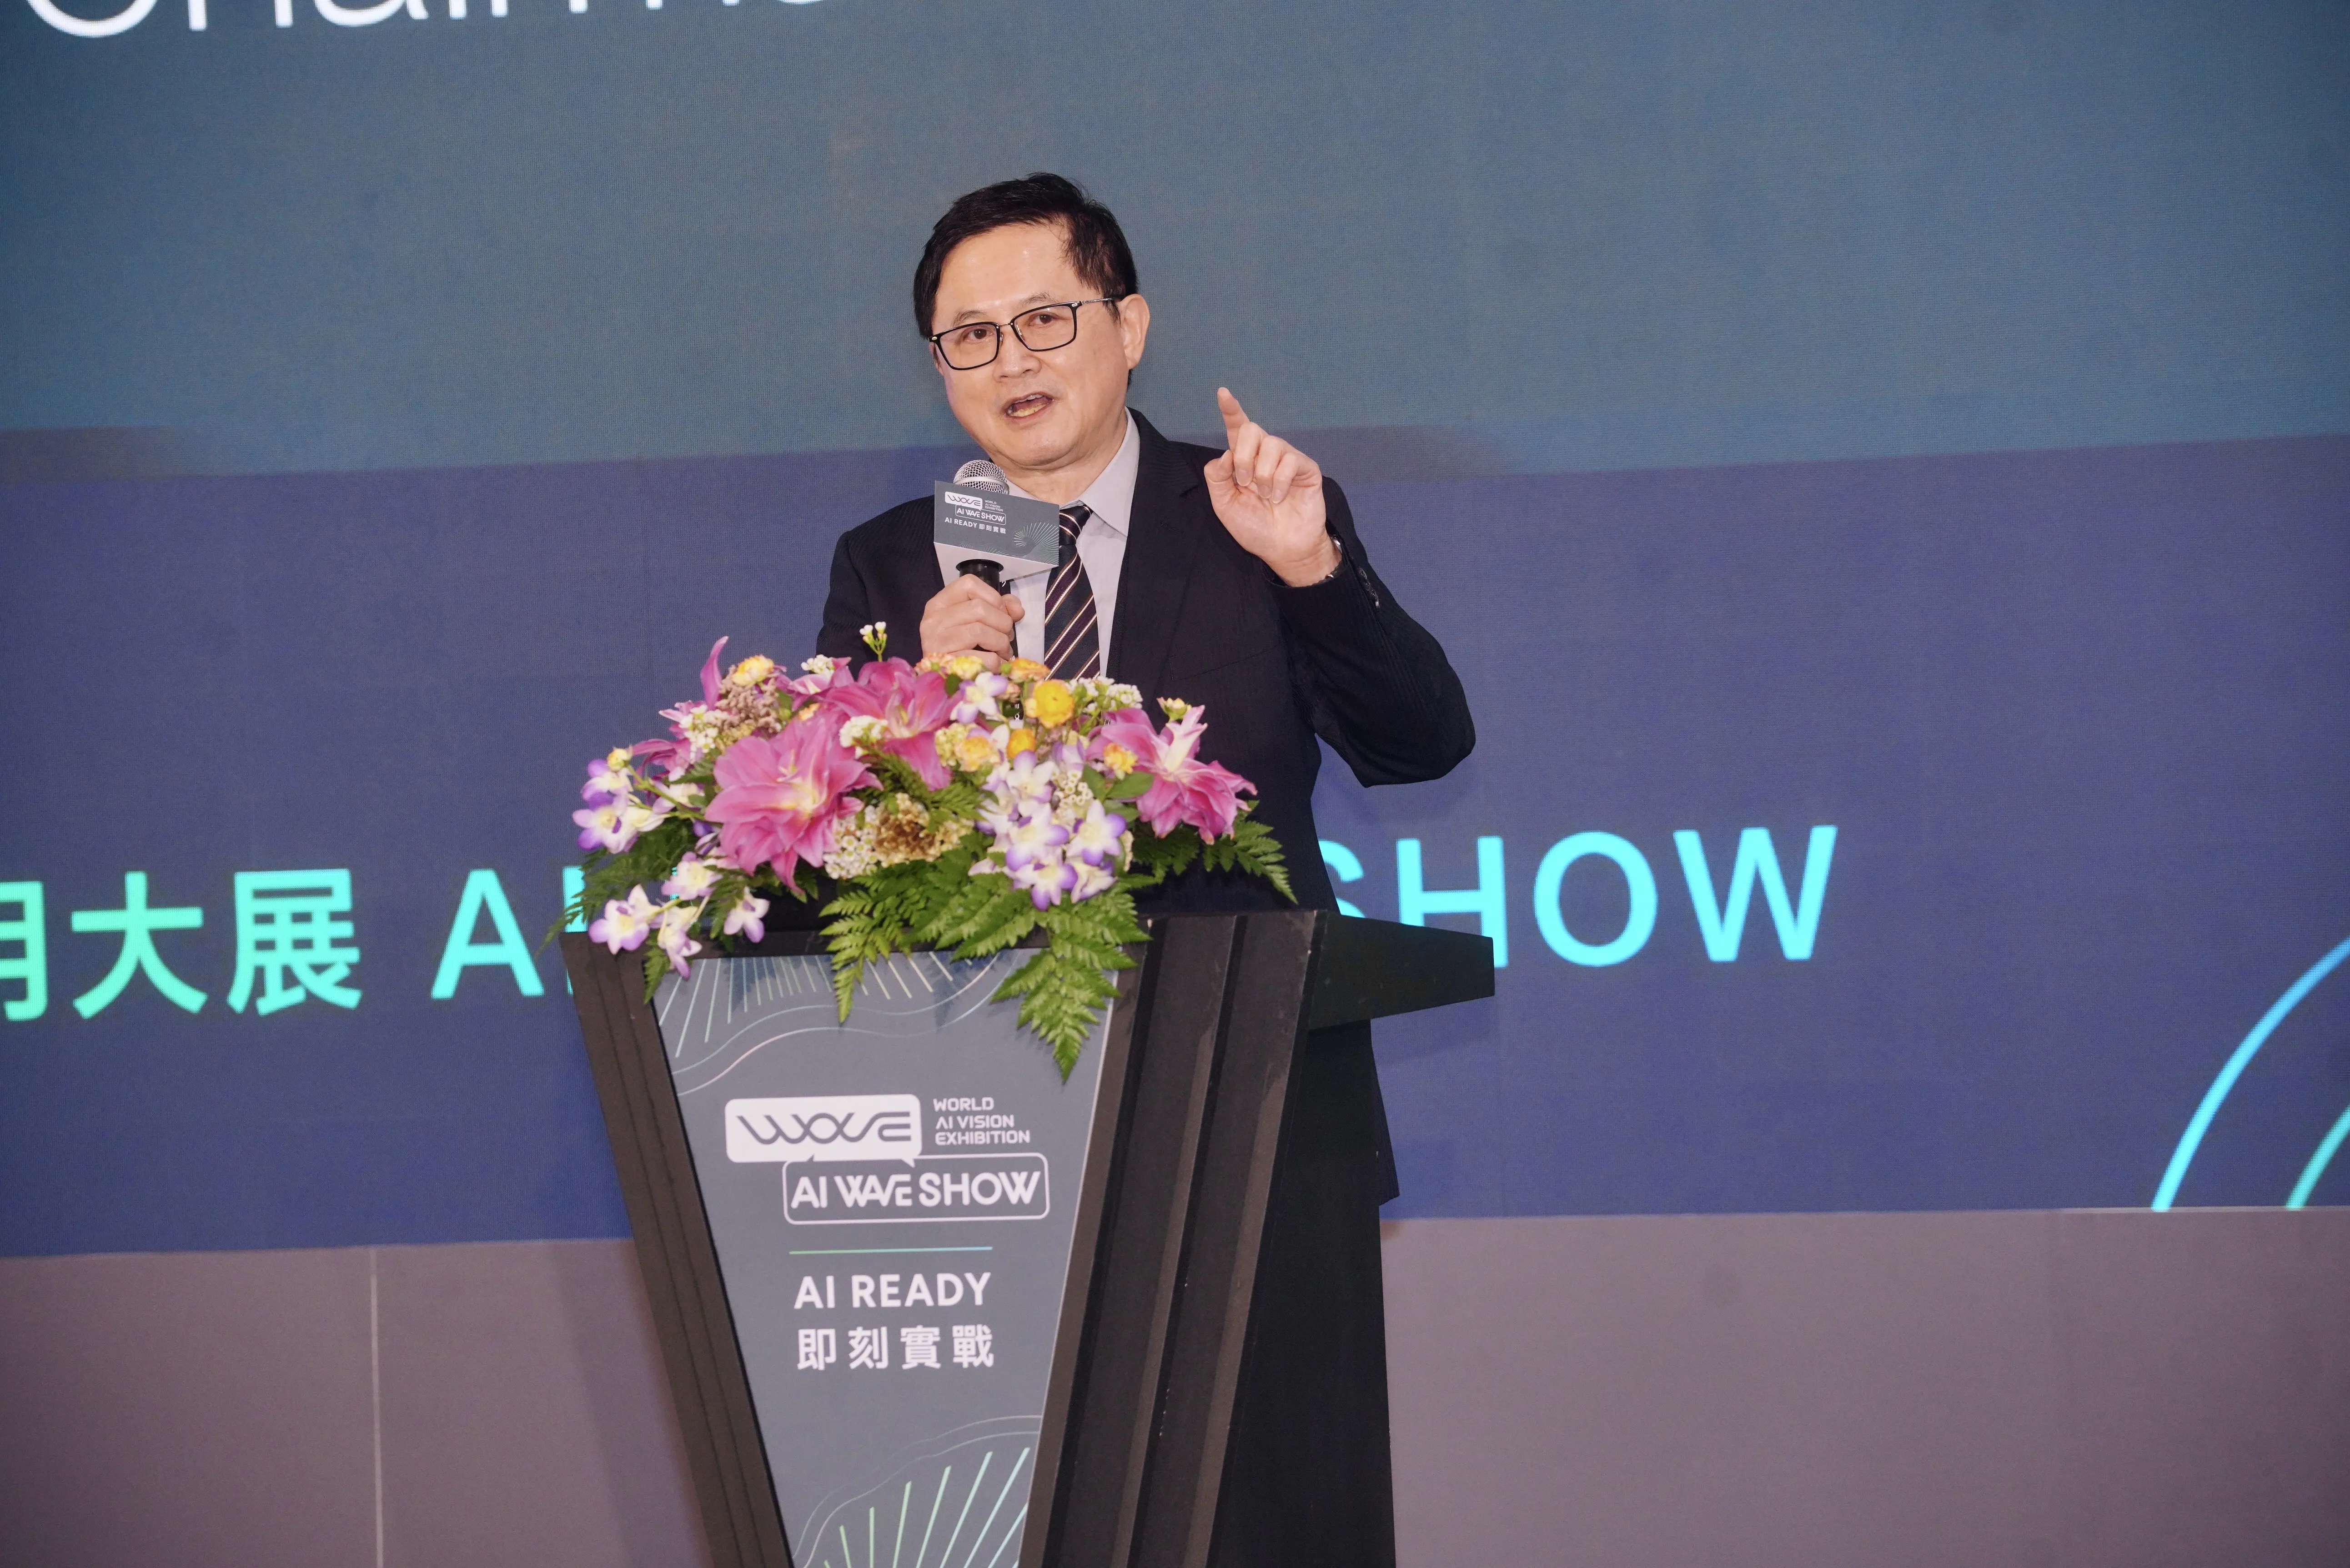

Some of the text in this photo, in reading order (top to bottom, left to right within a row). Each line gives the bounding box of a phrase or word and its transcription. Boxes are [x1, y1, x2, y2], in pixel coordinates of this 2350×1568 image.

[954, 518, 978, 528] READY
[965, 509, 980, 518] WAVE
[981, 512, 1004, 522] SHOW
[933, 1097, 994, 1111] WORLD
[936, 1114, 1014, 1130] AI VISION
[934, 1130, 1030, 1146] EXHIBITION
[790, 1171, 1041, 1209] AI WAVE SHOW
[794, 1272, 991, 1310] AI READY
[797, 1325, 994, 1371] 即刻實戰
